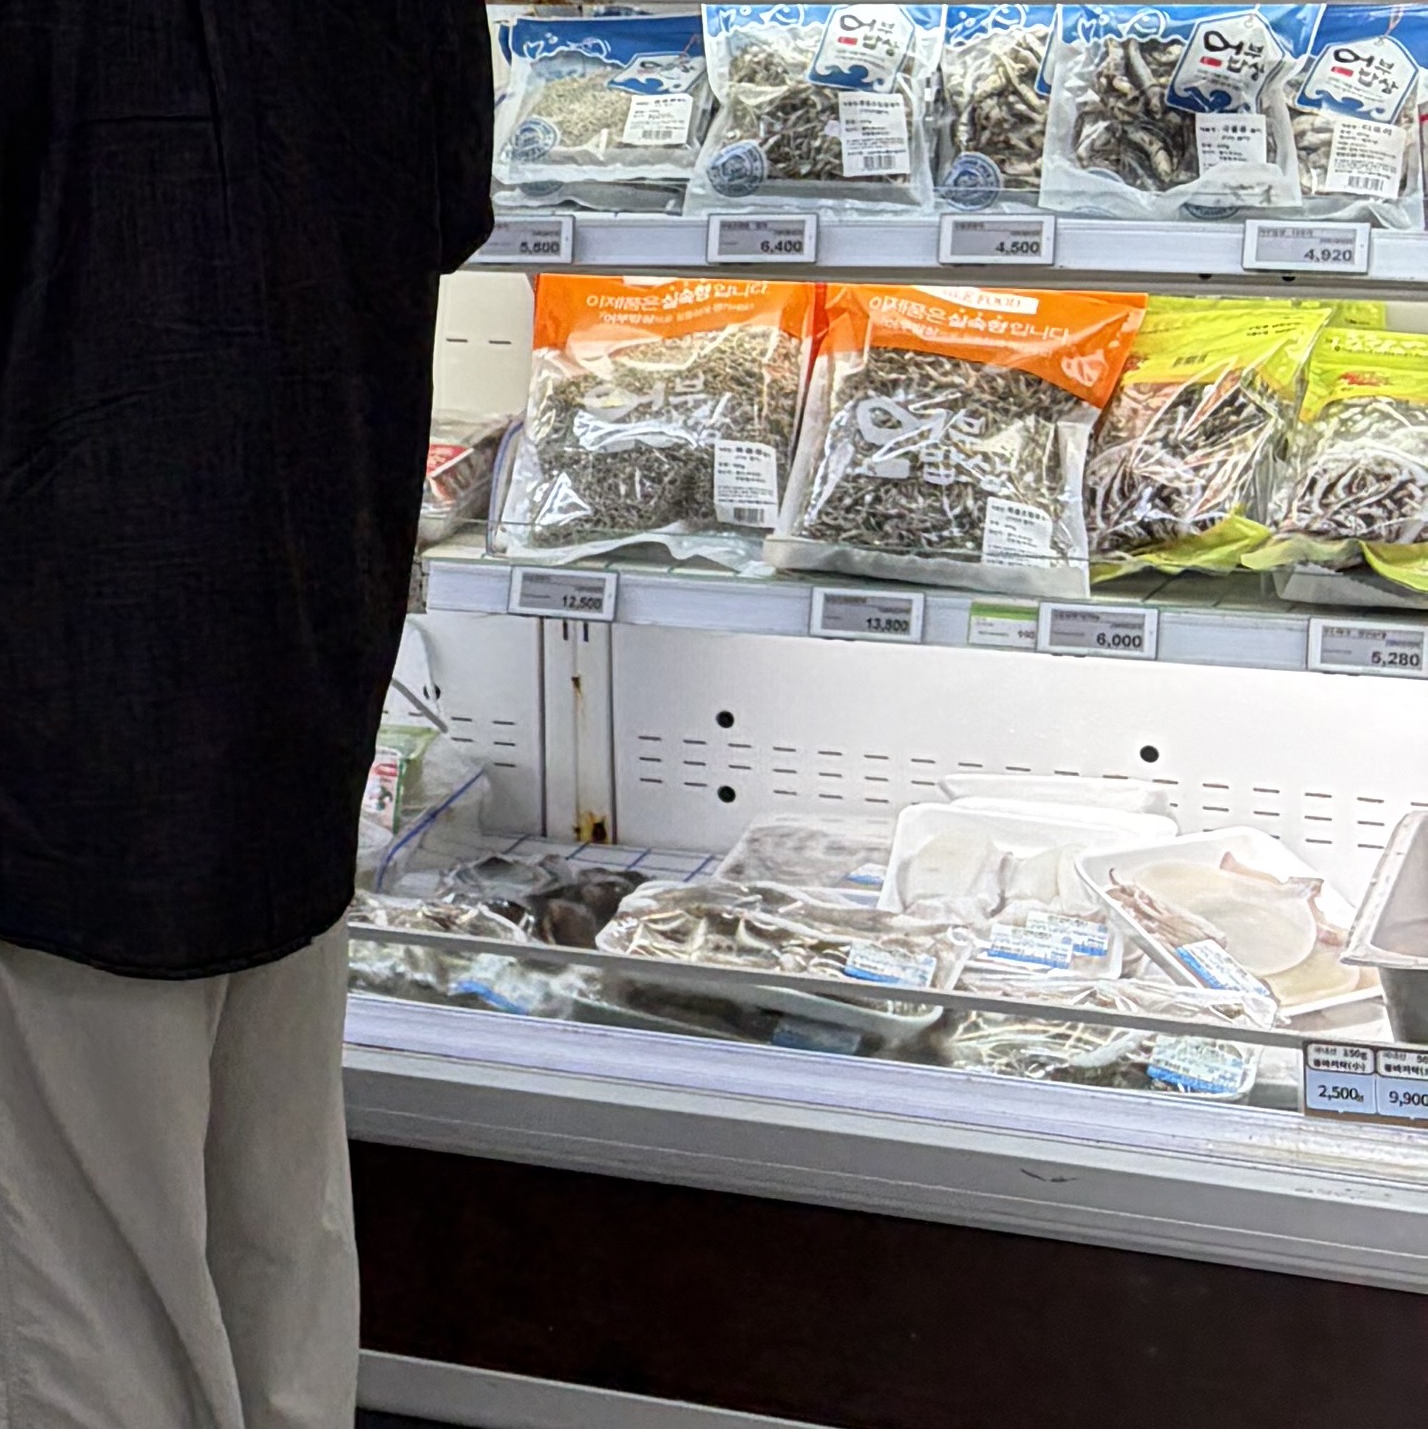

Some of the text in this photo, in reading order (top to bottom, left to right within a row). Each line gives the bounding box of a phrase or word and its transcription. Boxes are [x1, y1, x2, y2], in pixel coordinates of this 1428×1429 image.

[995, 240, 1041, 257] 4,500
[1303, 247, 1353, 265] 4,920
[1096, 631, 1144, 650] 6,000
